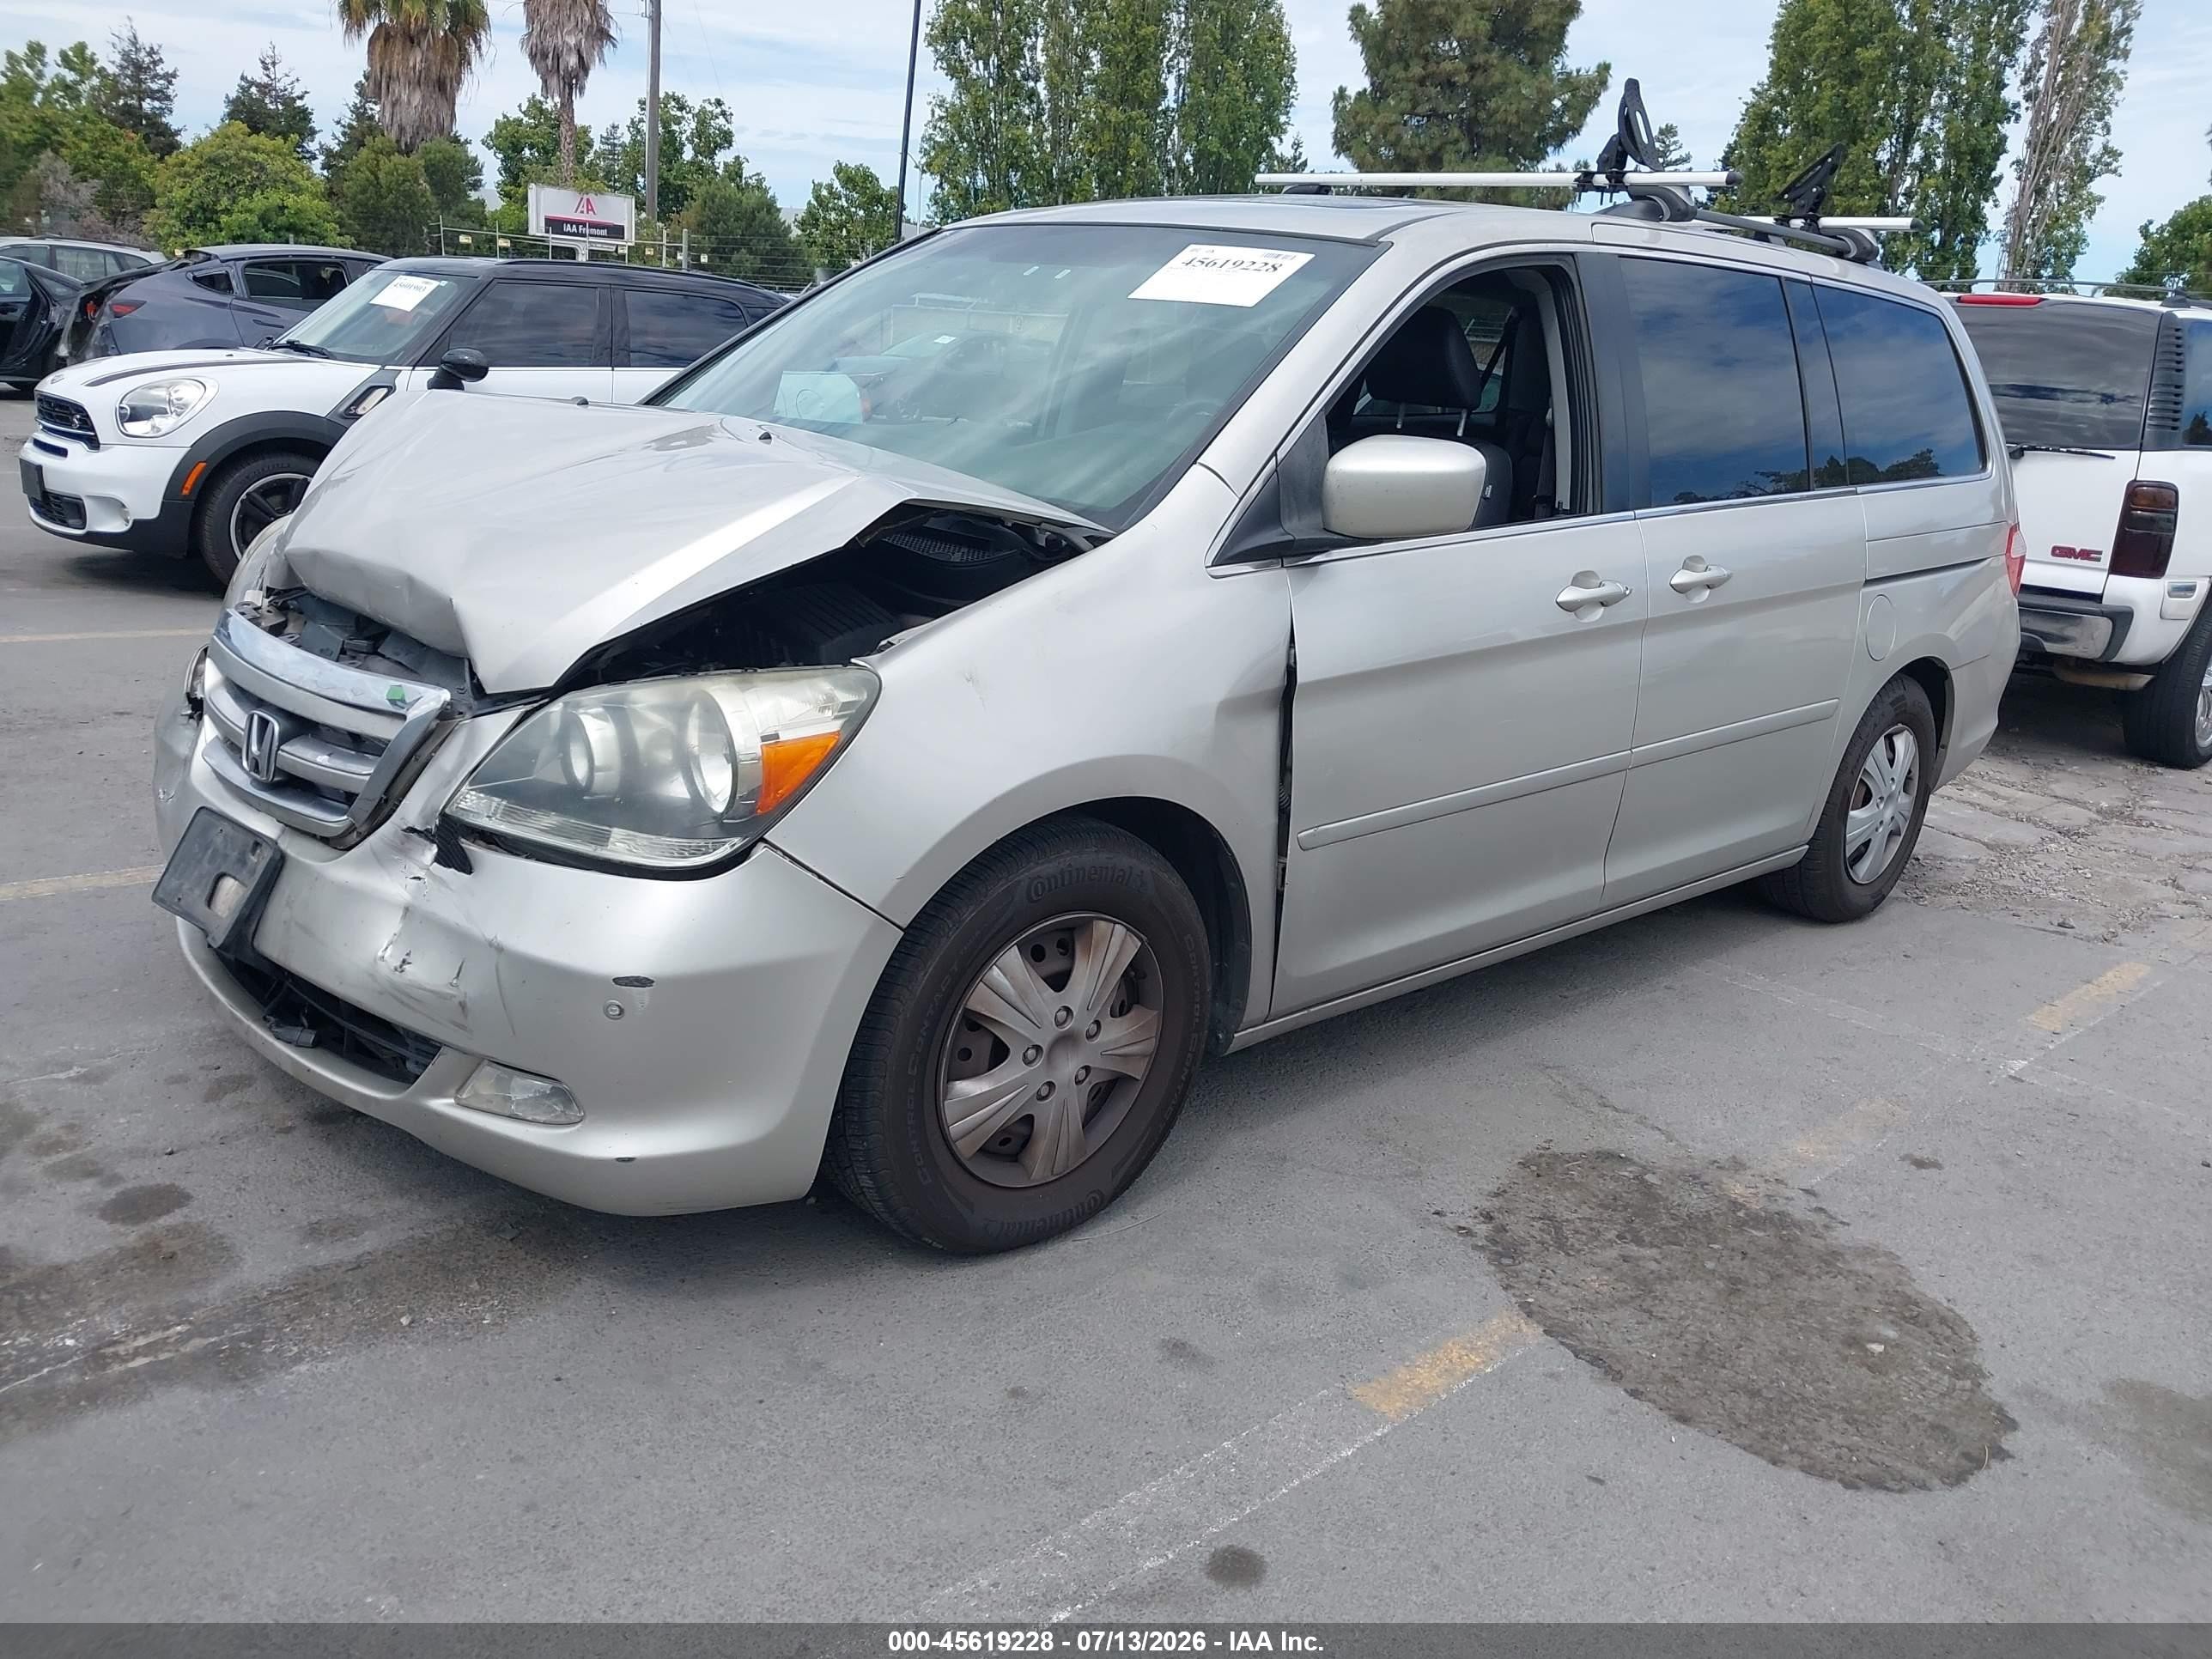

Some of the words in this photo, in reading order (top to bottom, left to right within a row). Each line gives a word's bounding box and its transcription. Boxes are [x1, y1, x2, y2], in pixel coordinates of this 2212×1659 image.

[563, 223, 577, 233] IAA
[1182, 256, 1283, 273] 45619228
[2051, 544, 2103, 562] GMC
[1027, 864, 1133, 904] Continental
